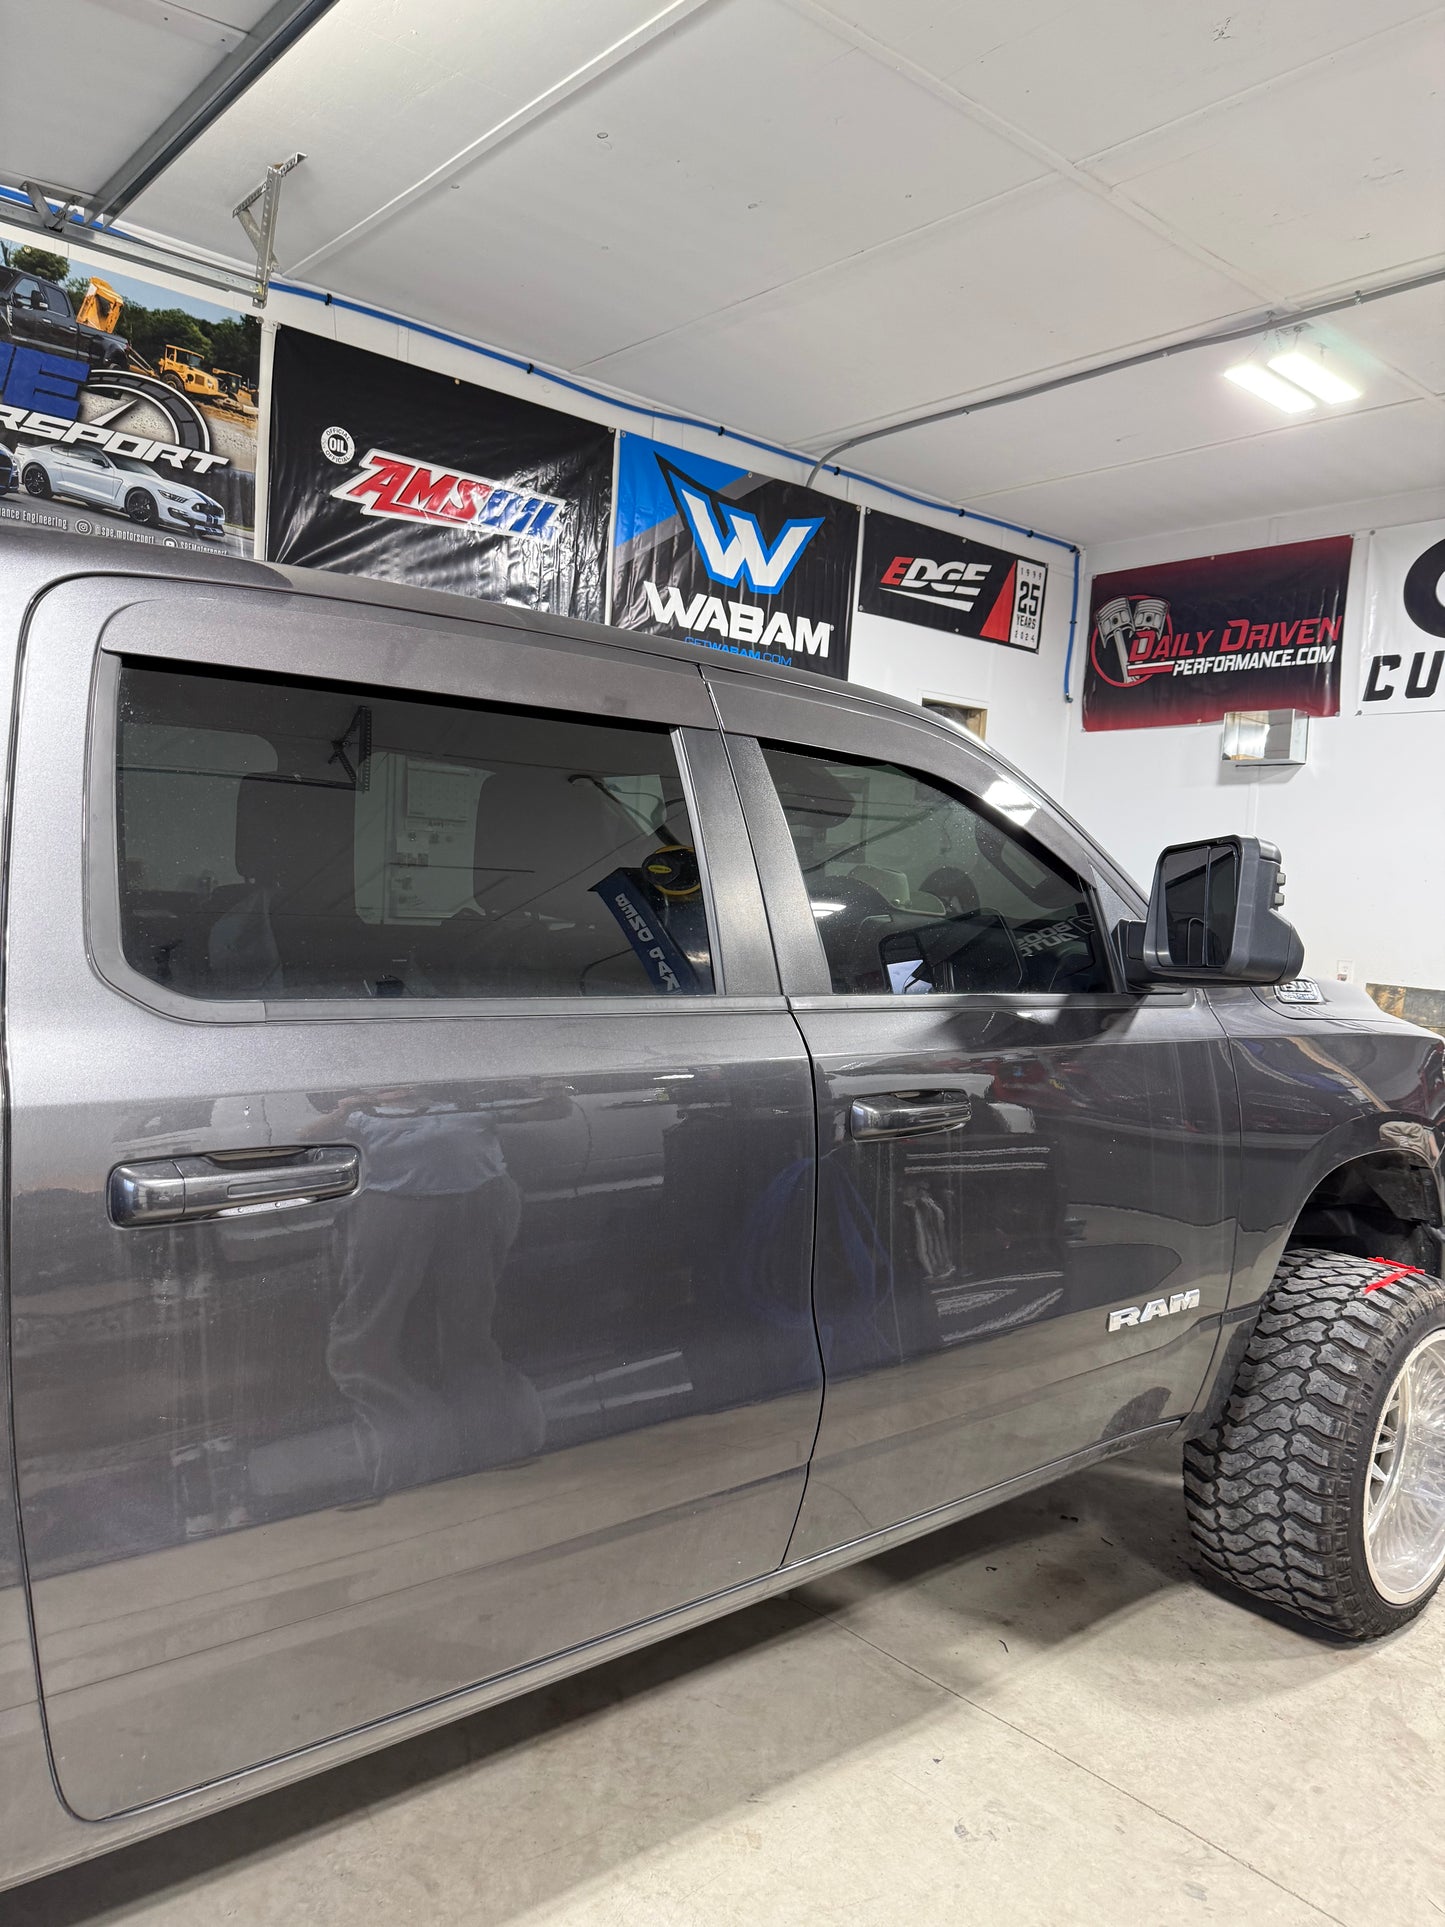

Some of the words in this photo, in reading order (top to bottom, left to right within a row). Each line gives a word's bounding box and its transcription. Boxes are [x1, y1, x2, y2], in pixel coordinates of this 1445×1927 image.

[0, 340, 90, 421] E
[325, 428, 351, 442] OFFICIAL
[329, 437, 347, 454] OIL
[325, 450, 351, 463] OFFICIAL
[346, 455, 559, 541] AMSOIL
[0, 507, 20, 520] ance
[22, 510, 67, 530] Engineering
[95, 524, 154, 545] @spe.motorsport
[880, 556, 992, 597] EDGE
[1021, 567, 1042, 581] 1999
[1017, 580, 1041, 617] 25
[643, 580, 832, 658] WABAM
[1016, 613, 1037, 630] YEARS
[684, 636, 793, 667] GETWABAMCOM
[1014, 630, 1035, 643] 2024
[1128, 629, 1215, 662] DAILY
[1219, 615, 1343, 652] DRIVEN
[1173, 645, 1337, 677] PERFORMANCE.COM
[1106, 1288, 1200, 1333] RAM
